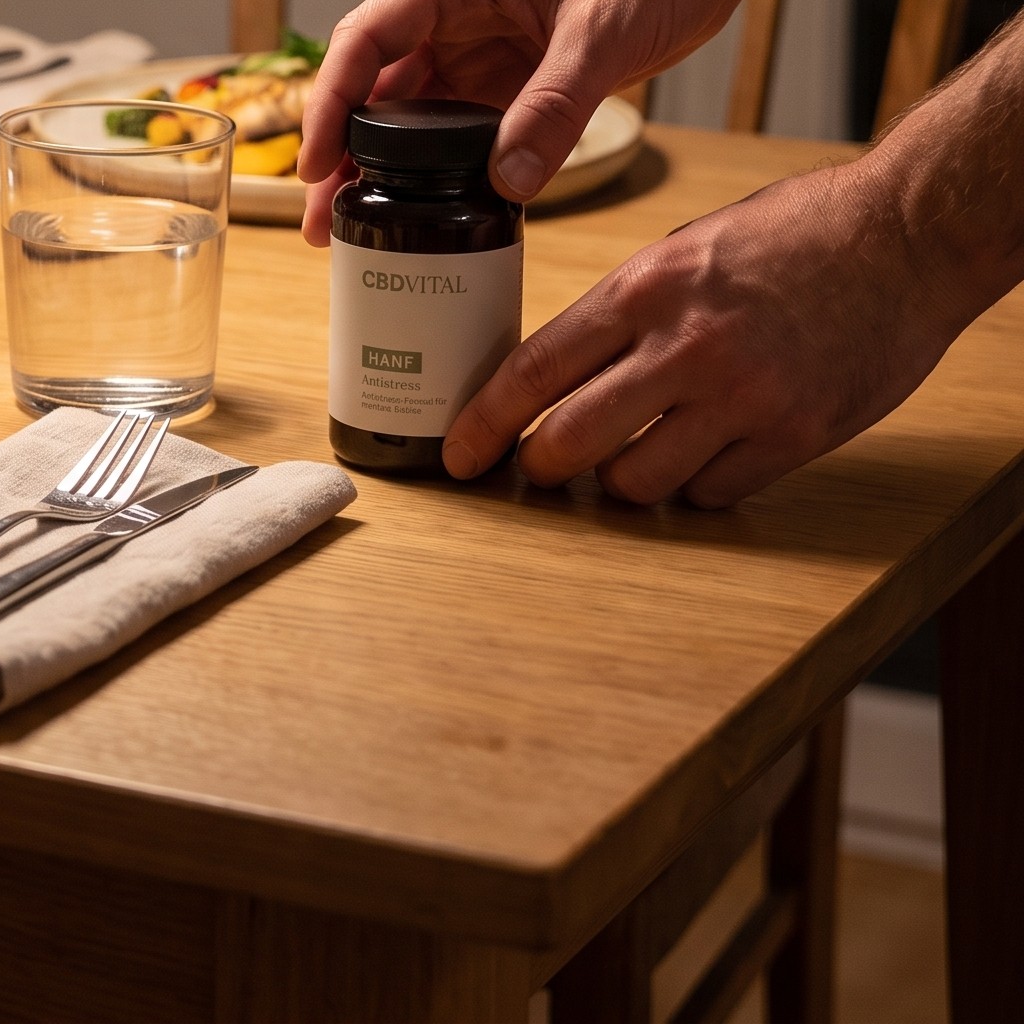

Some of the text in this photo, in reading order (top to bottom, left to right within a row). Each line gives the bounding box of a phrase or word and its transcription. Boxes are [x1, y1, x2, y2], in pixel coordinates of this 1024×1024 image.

[362, 270, 468, 294] CBDVITAL
[368, 351, 414, 369] HANF
[361, 374, 421, 391] Antistress
